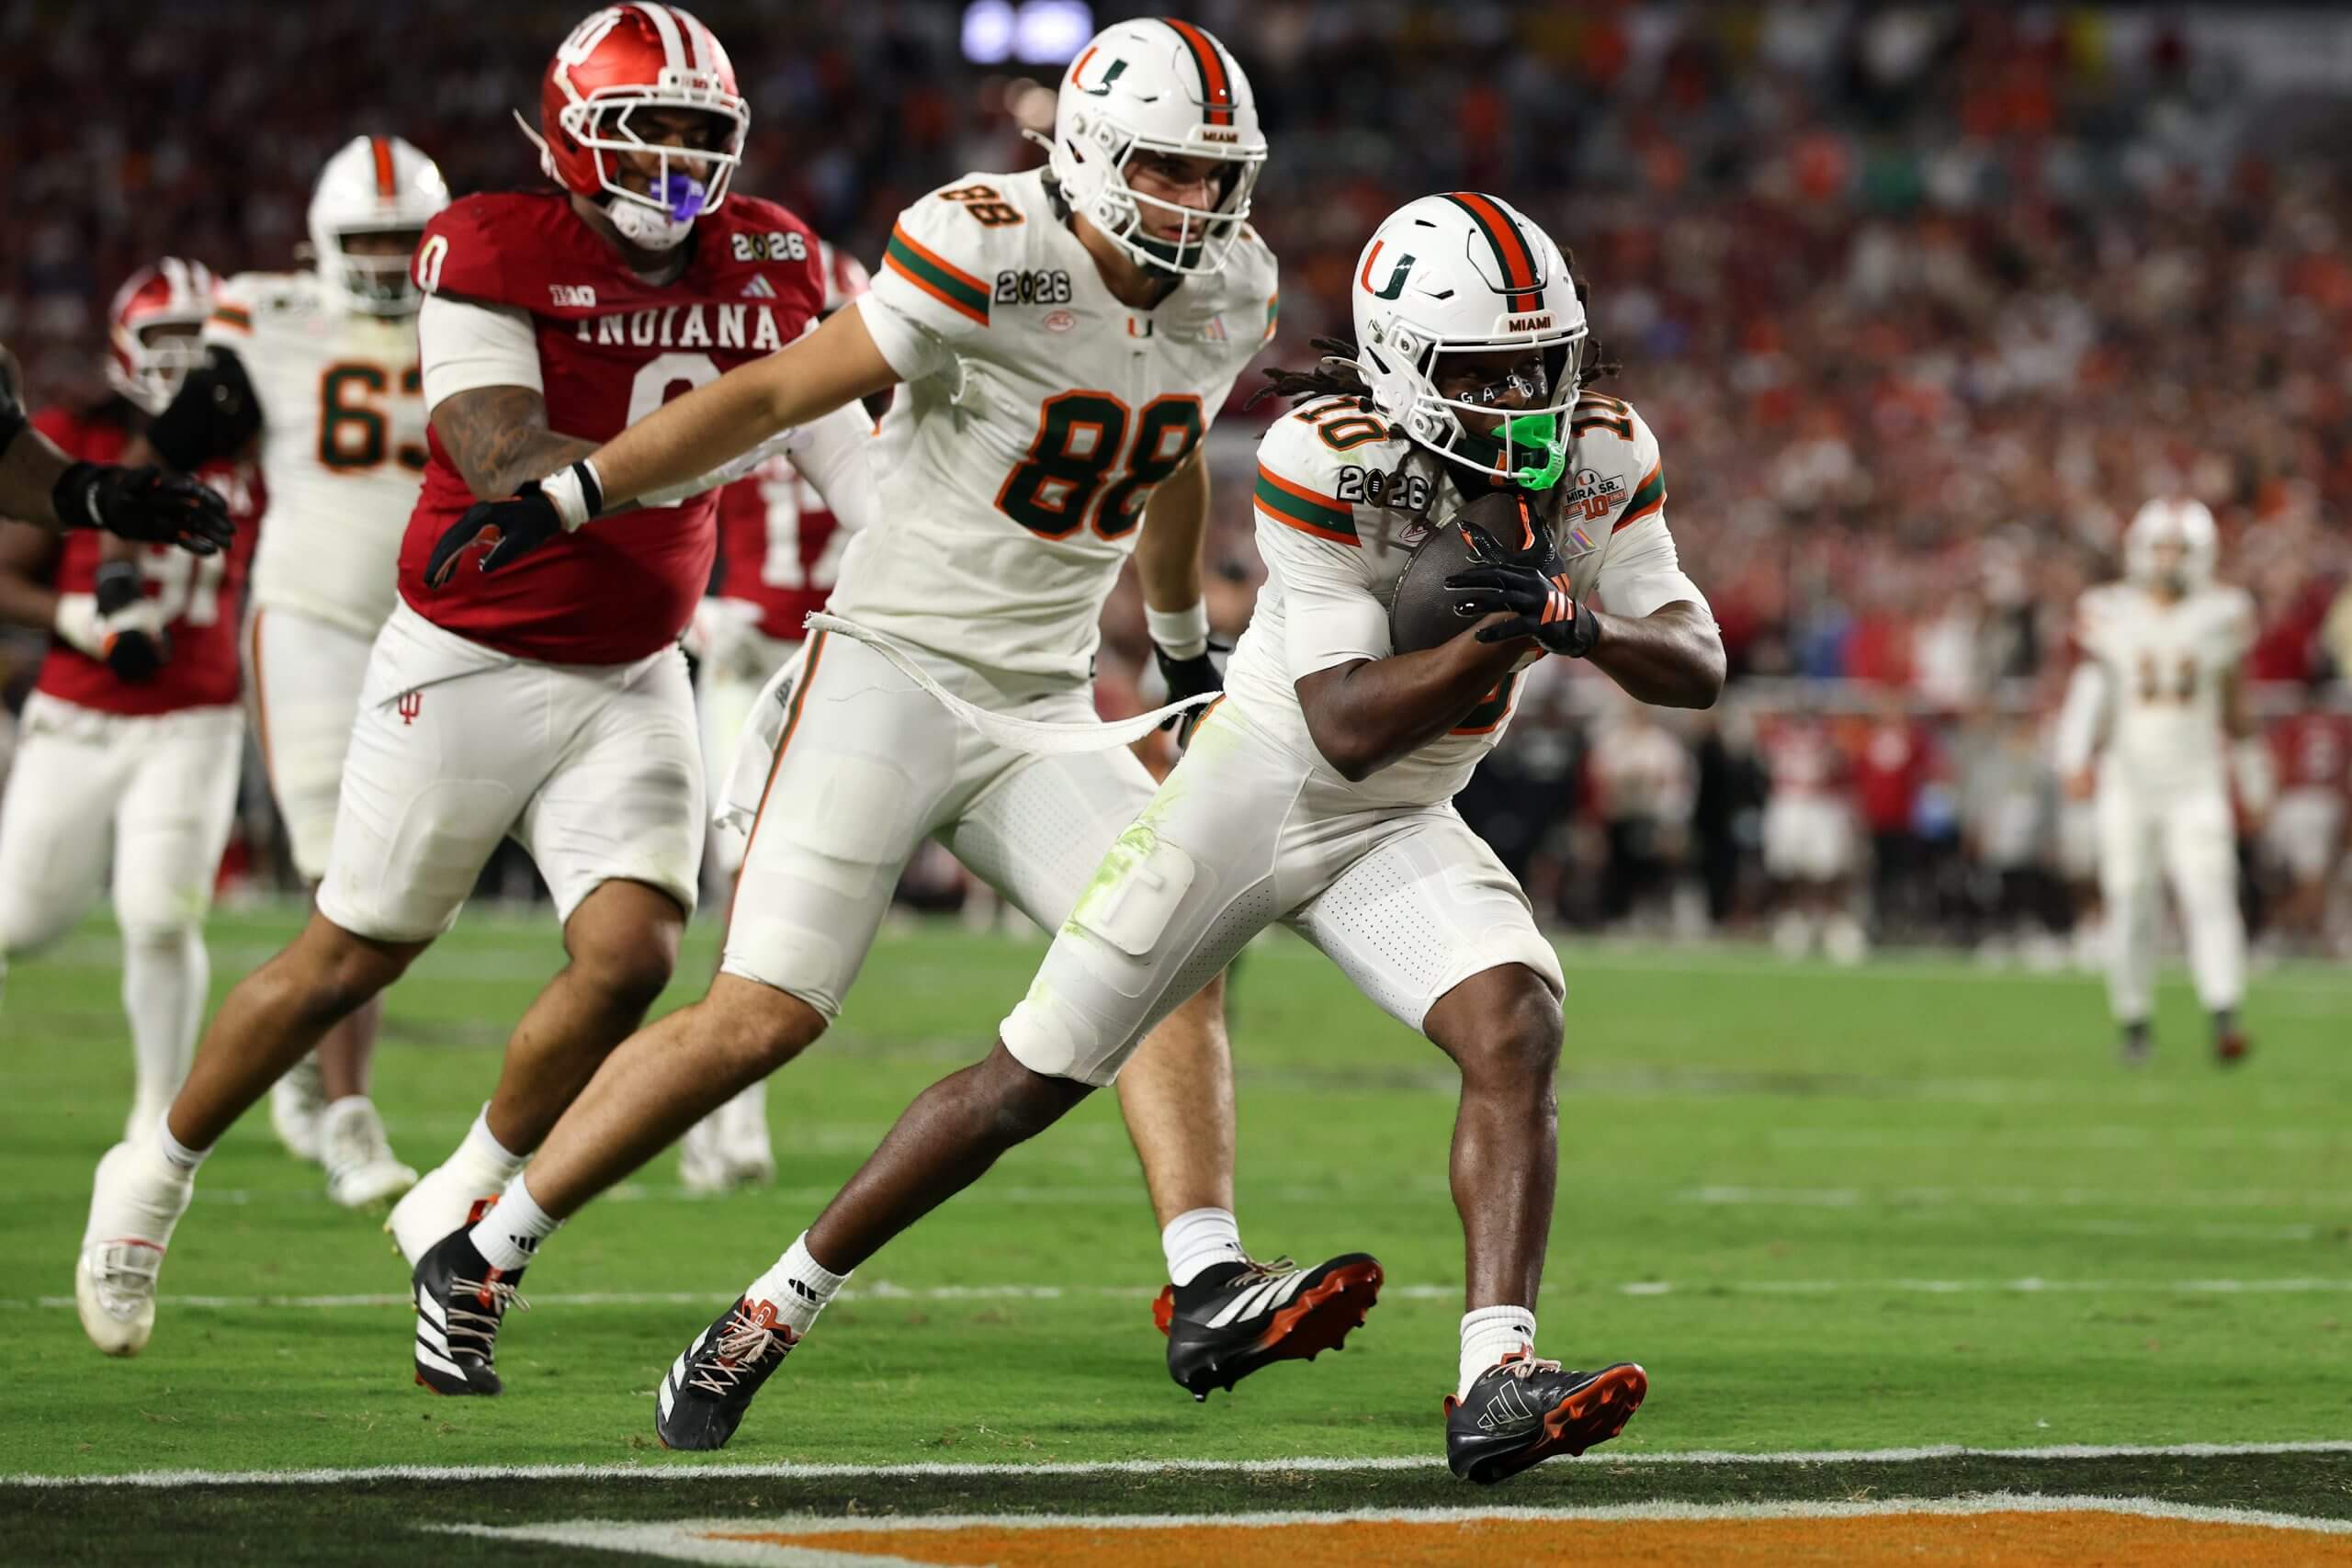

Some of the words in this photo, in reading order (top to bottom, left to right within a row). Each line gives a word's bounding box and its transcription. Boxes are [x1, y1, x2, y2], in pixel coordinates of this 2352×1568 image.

[1072, 46, 1129, 96] U
[1203, 131, 1238, 143] MIAMI
[938, 185, 1025, 227] 88
[732, 232, 808, 261] 2026
[995, 270, 1071, 306] 2026
[1361, 240, 1416, 300] U
[576, 303, 784, 351] INDIANA
[1508, 316, 1552, 332] MIAMI
[1293, 396, 1389, 452] 10
[993, 389, 1205, 541] 88
[1336, 465, 1430, 512] 2026
[1566, 486, 1597, 503] MIRA
[1599, 480, 1620, 494] SR.
[1580, 494, 1610, 522] 10
